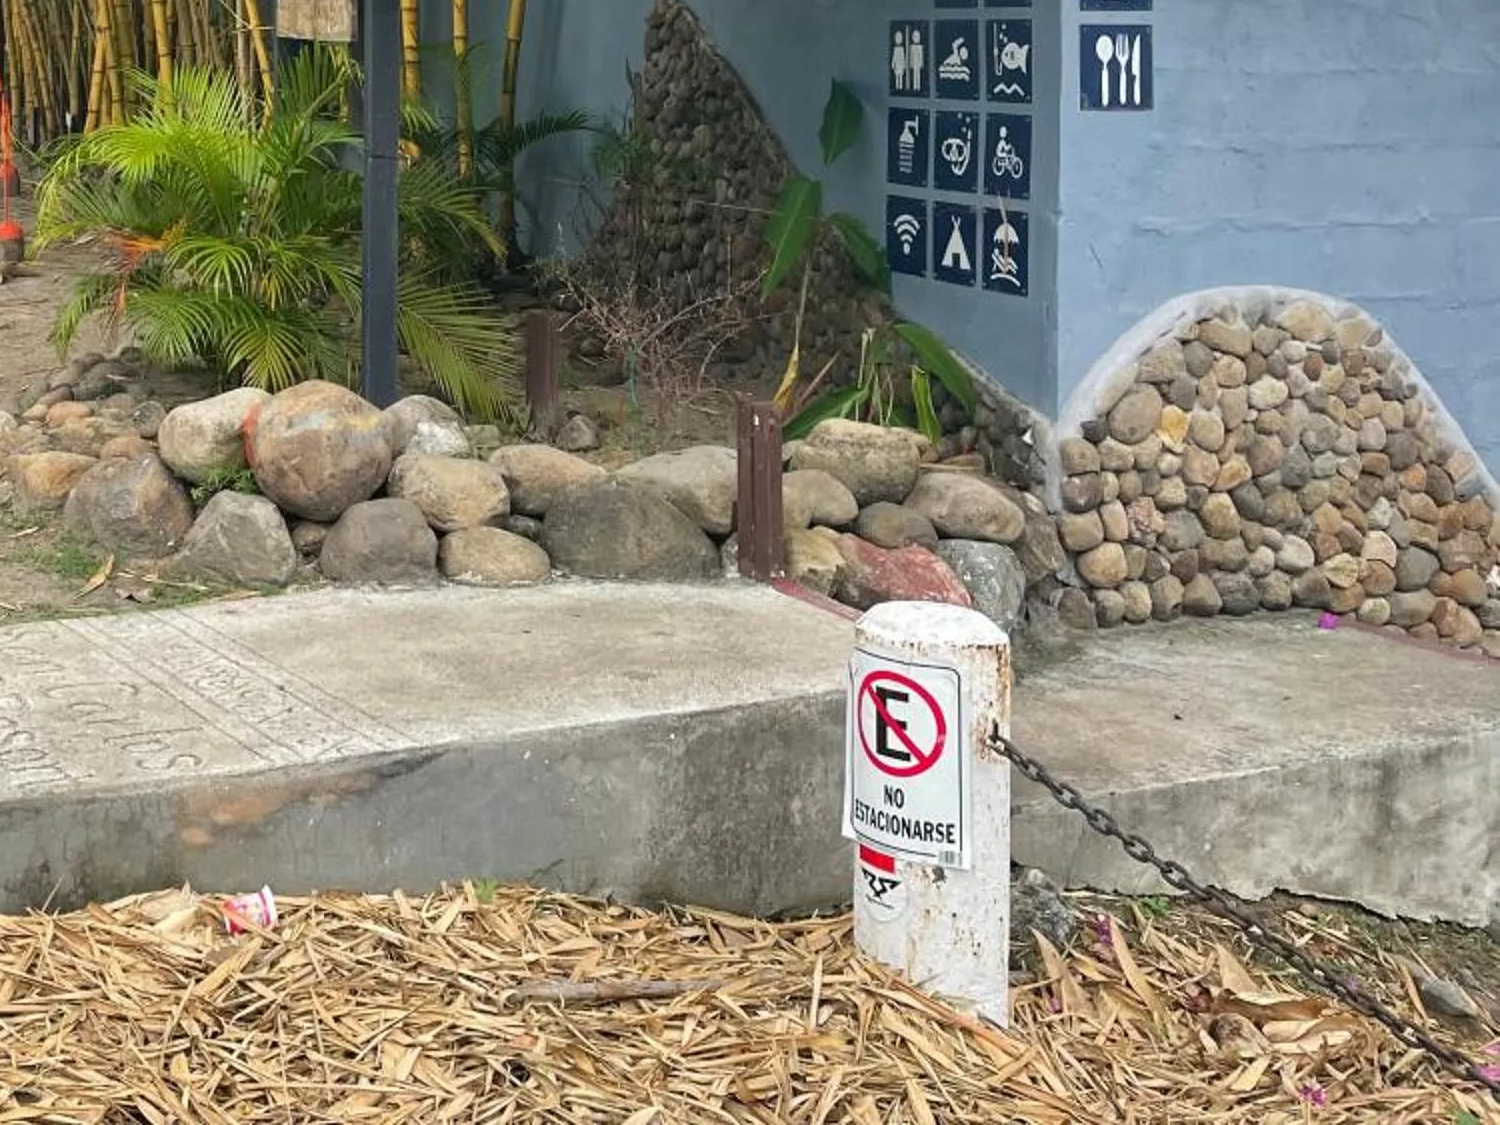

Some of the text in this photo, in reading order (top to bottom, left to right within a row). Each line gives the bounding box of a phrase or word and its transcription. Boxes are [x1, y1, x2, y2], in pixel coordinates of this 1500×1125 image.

[876, 686, 911, 762] E
[884, 784, 905, 809] NO
[855, 797, 956, 844] ESTACIONARSE
